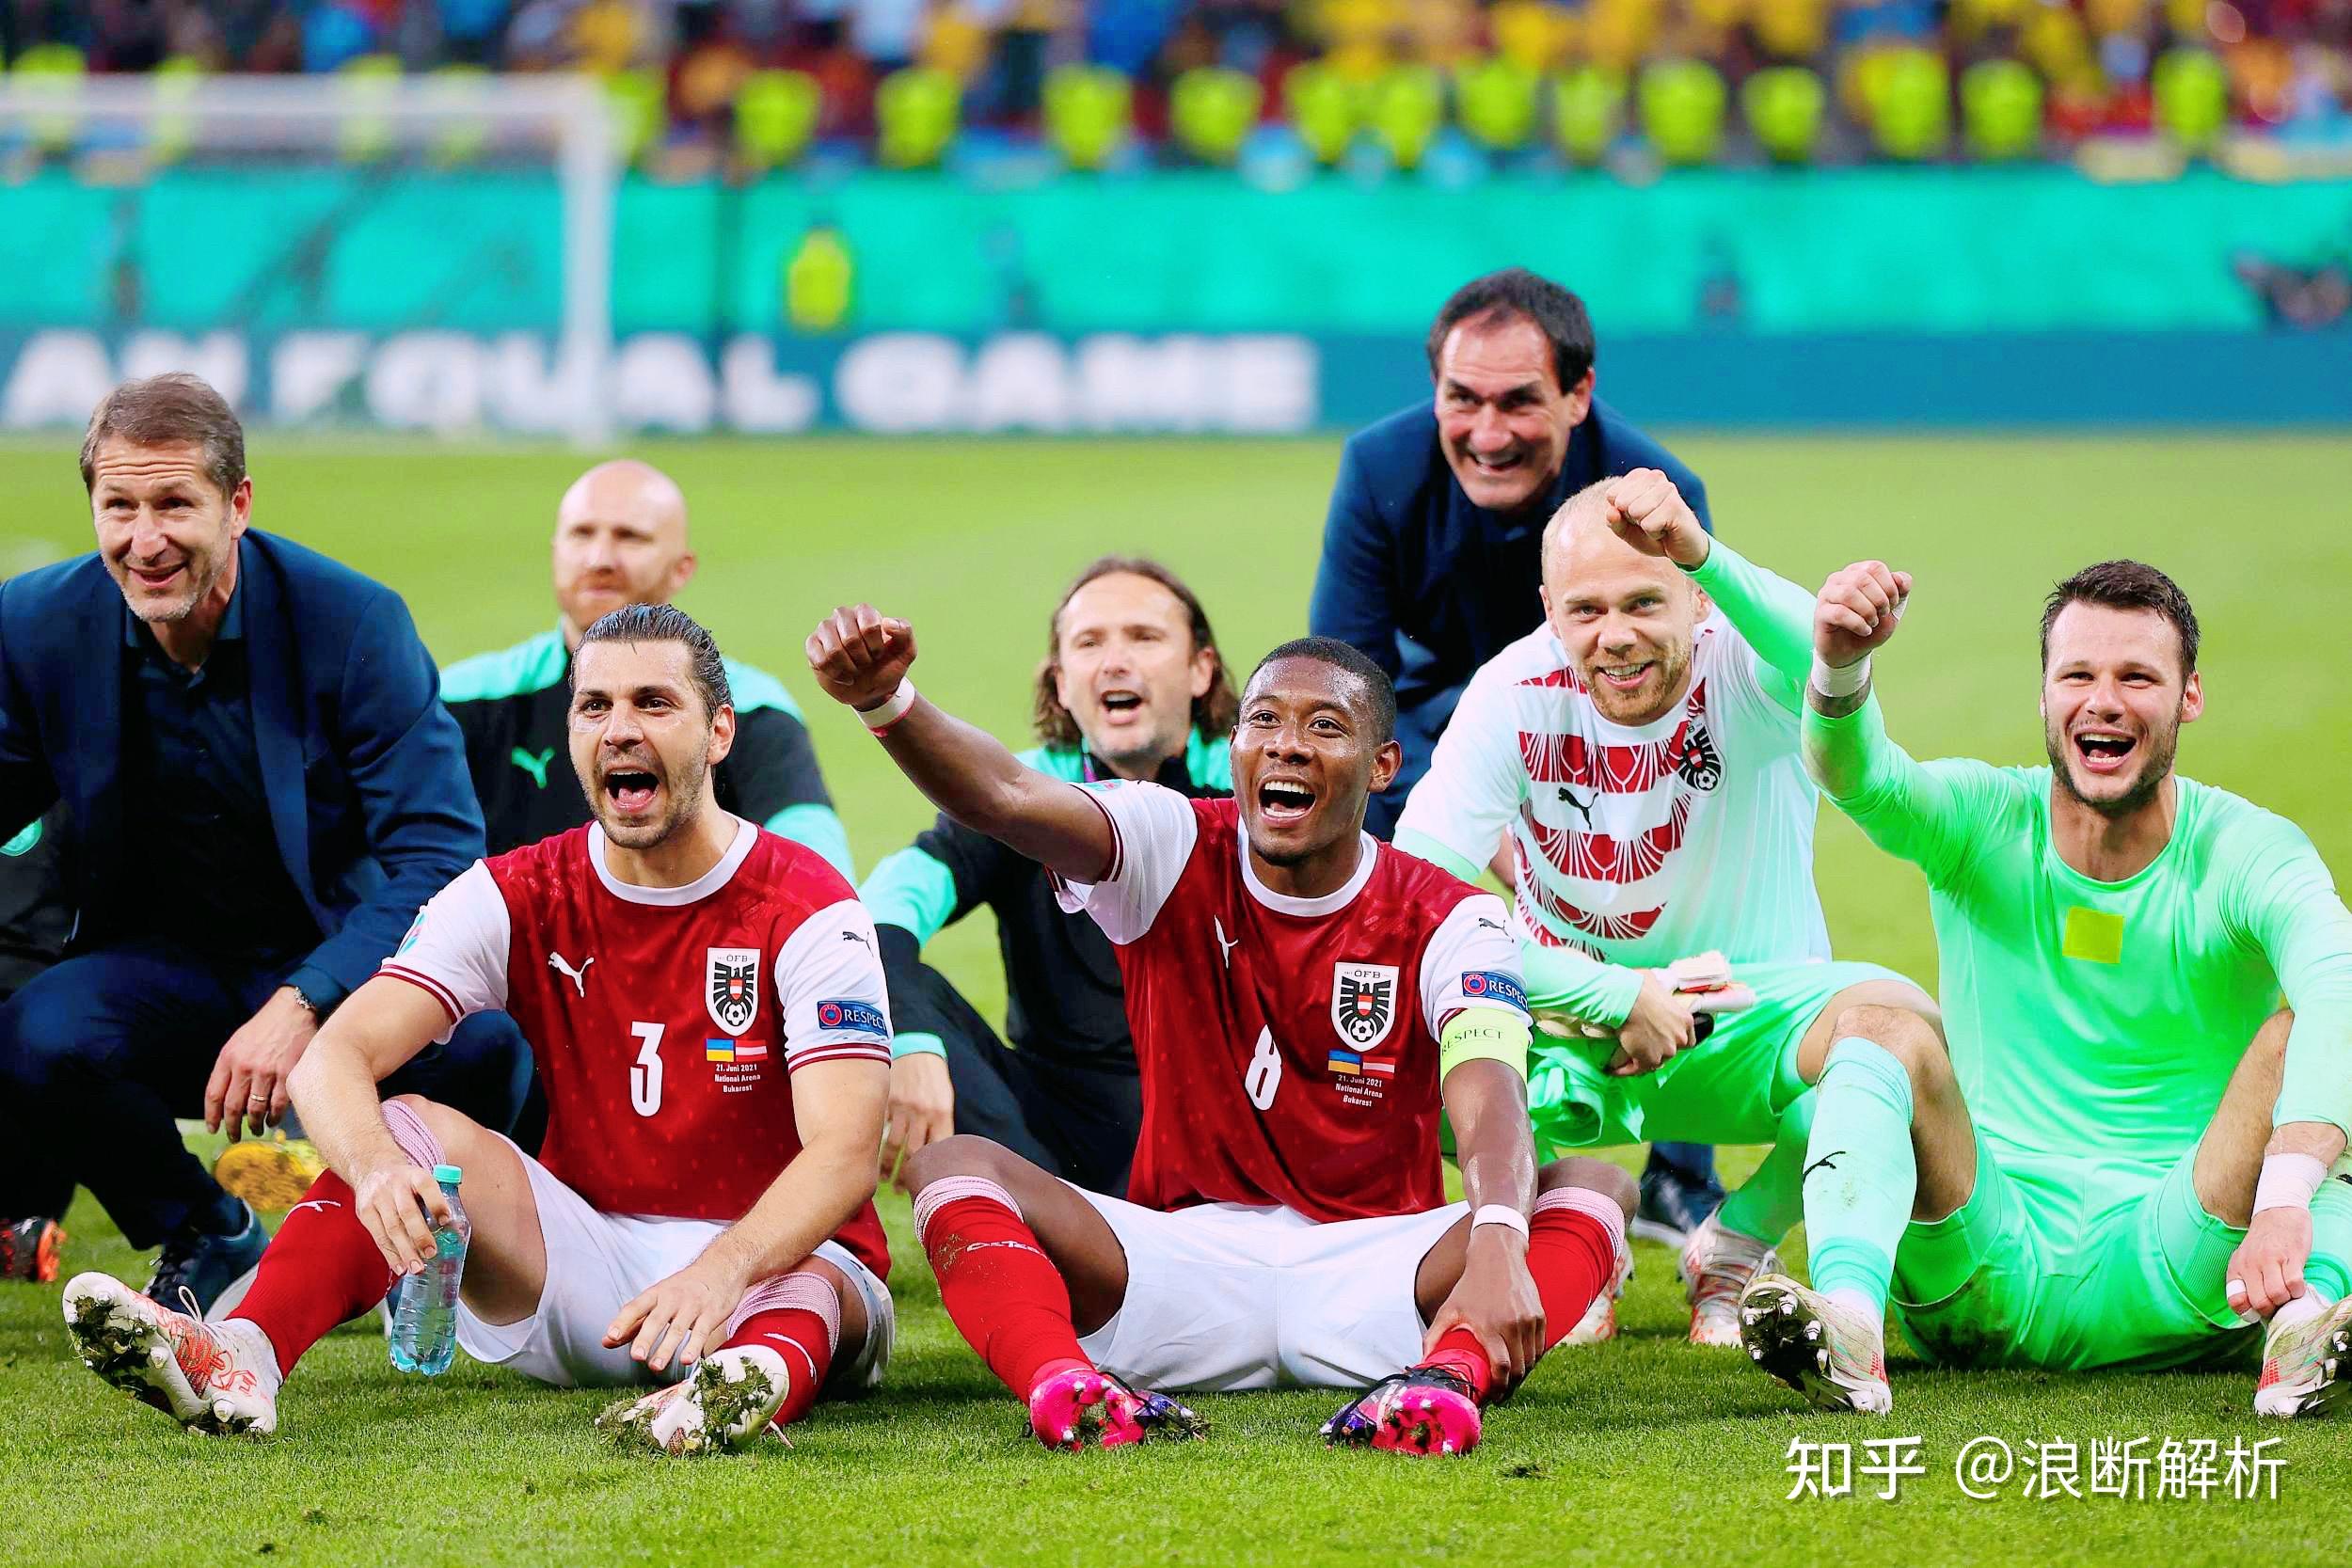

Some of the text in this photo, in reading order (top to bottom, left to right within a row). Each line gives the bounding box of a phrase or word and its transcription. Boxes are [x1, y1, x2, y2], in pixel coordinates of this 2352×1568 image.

[837, 329, 1314, 435] GAME
[629, 1021, 666, 1117] 3
[740, 1063, 757, 1072] 2021
[1245, 1023, 1282, 1110] 8
[714, 1074, 761, 1083] National Arena
[1366, 1077, 1382, 1087] 2021
[1335, 1083, 1383, 1099] National Arena
[1343, 1094, 1373, 1107] Bukarest
